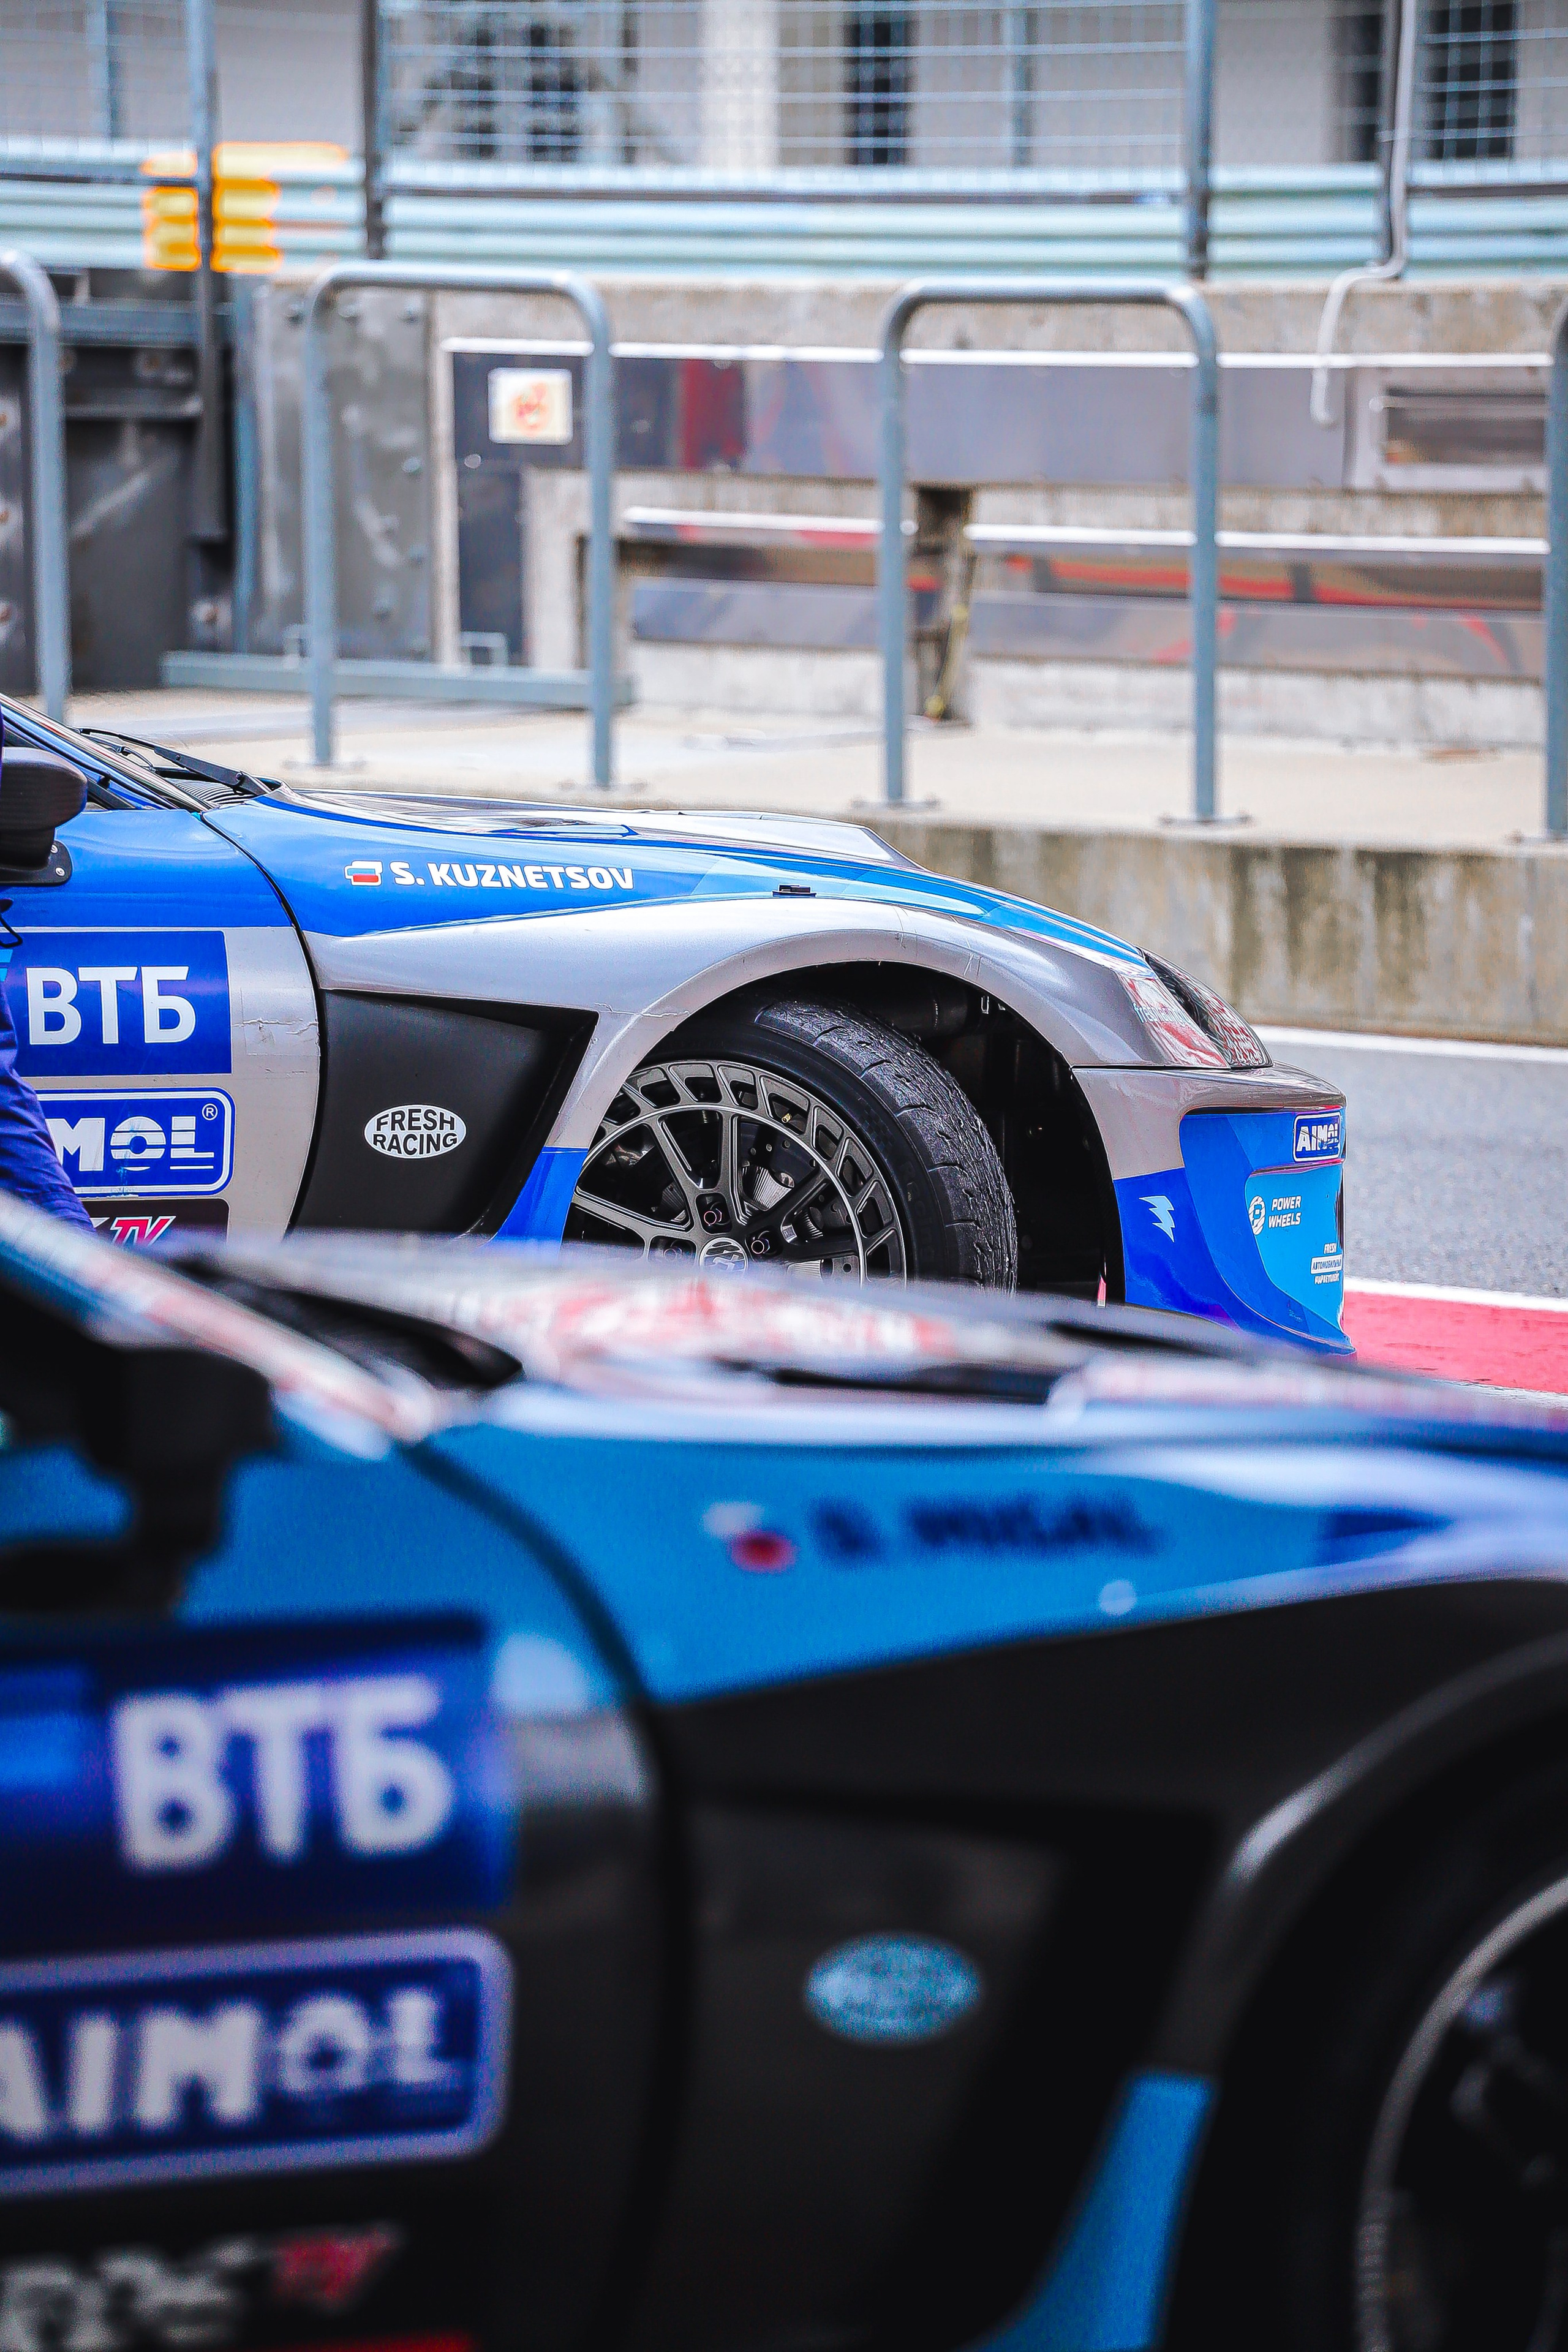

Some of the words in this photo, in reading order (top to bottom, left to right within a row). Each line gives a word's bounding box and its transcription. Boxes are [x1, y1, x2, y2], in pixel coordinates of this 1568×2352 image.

[390, 861, 425, 886] S.
[427, 862, 634, 889] KUZNETSOV
[26, 966, 196, 1045] ВТБ
[375, 1109, 454, 1131] FRESH
[45, 1116, 214, 1171] MOL
[372, 1133, 458, 1155] RACING
[1271, 1196, 1302, 1212] POWER
[1268, 1212, 1302, 1228] WHEELS
[114, 1673, 456, 1874] ВТБ
